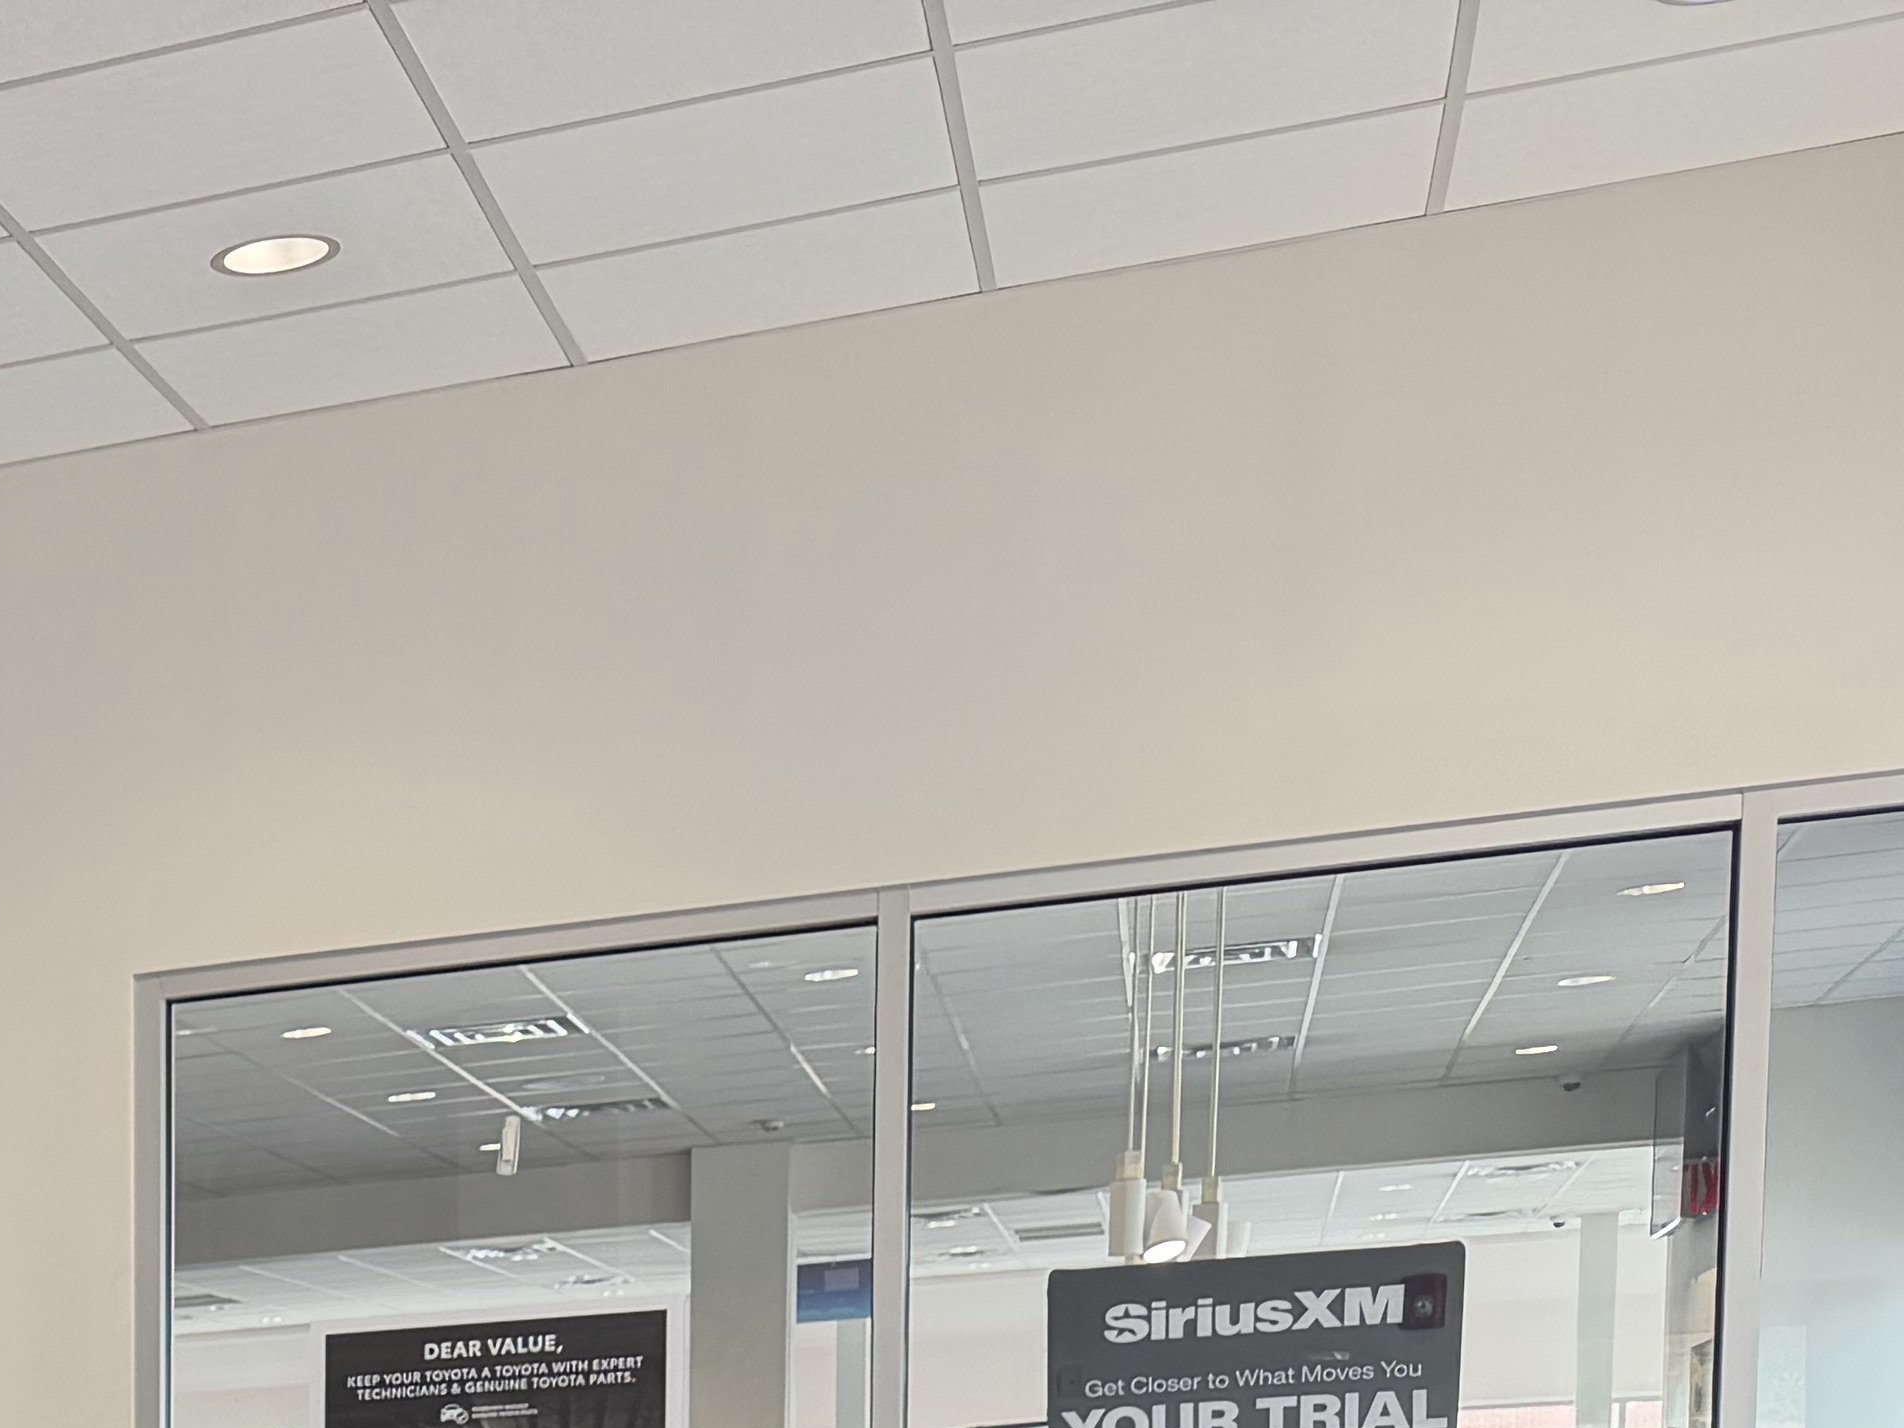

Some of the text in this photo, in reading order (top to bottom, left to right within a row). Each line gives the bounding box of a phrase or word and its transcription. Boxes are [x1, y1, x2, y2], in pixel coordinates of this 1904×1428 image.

[1103, 1284, 1405, 1344] SiriusXM
[423, 1334, 563, 1361] DEAR VALUE,
[346, 1355, 644, 1388] KEEP YOUR TOYOTA A TOYOTA WITH EXPERT
[356, 1370, 636, 1401] TECHNICIANS & GENUINE TOYOTA PARTS.
[1085, 1359, 1423, 1398] Get Closer to What Moves You
